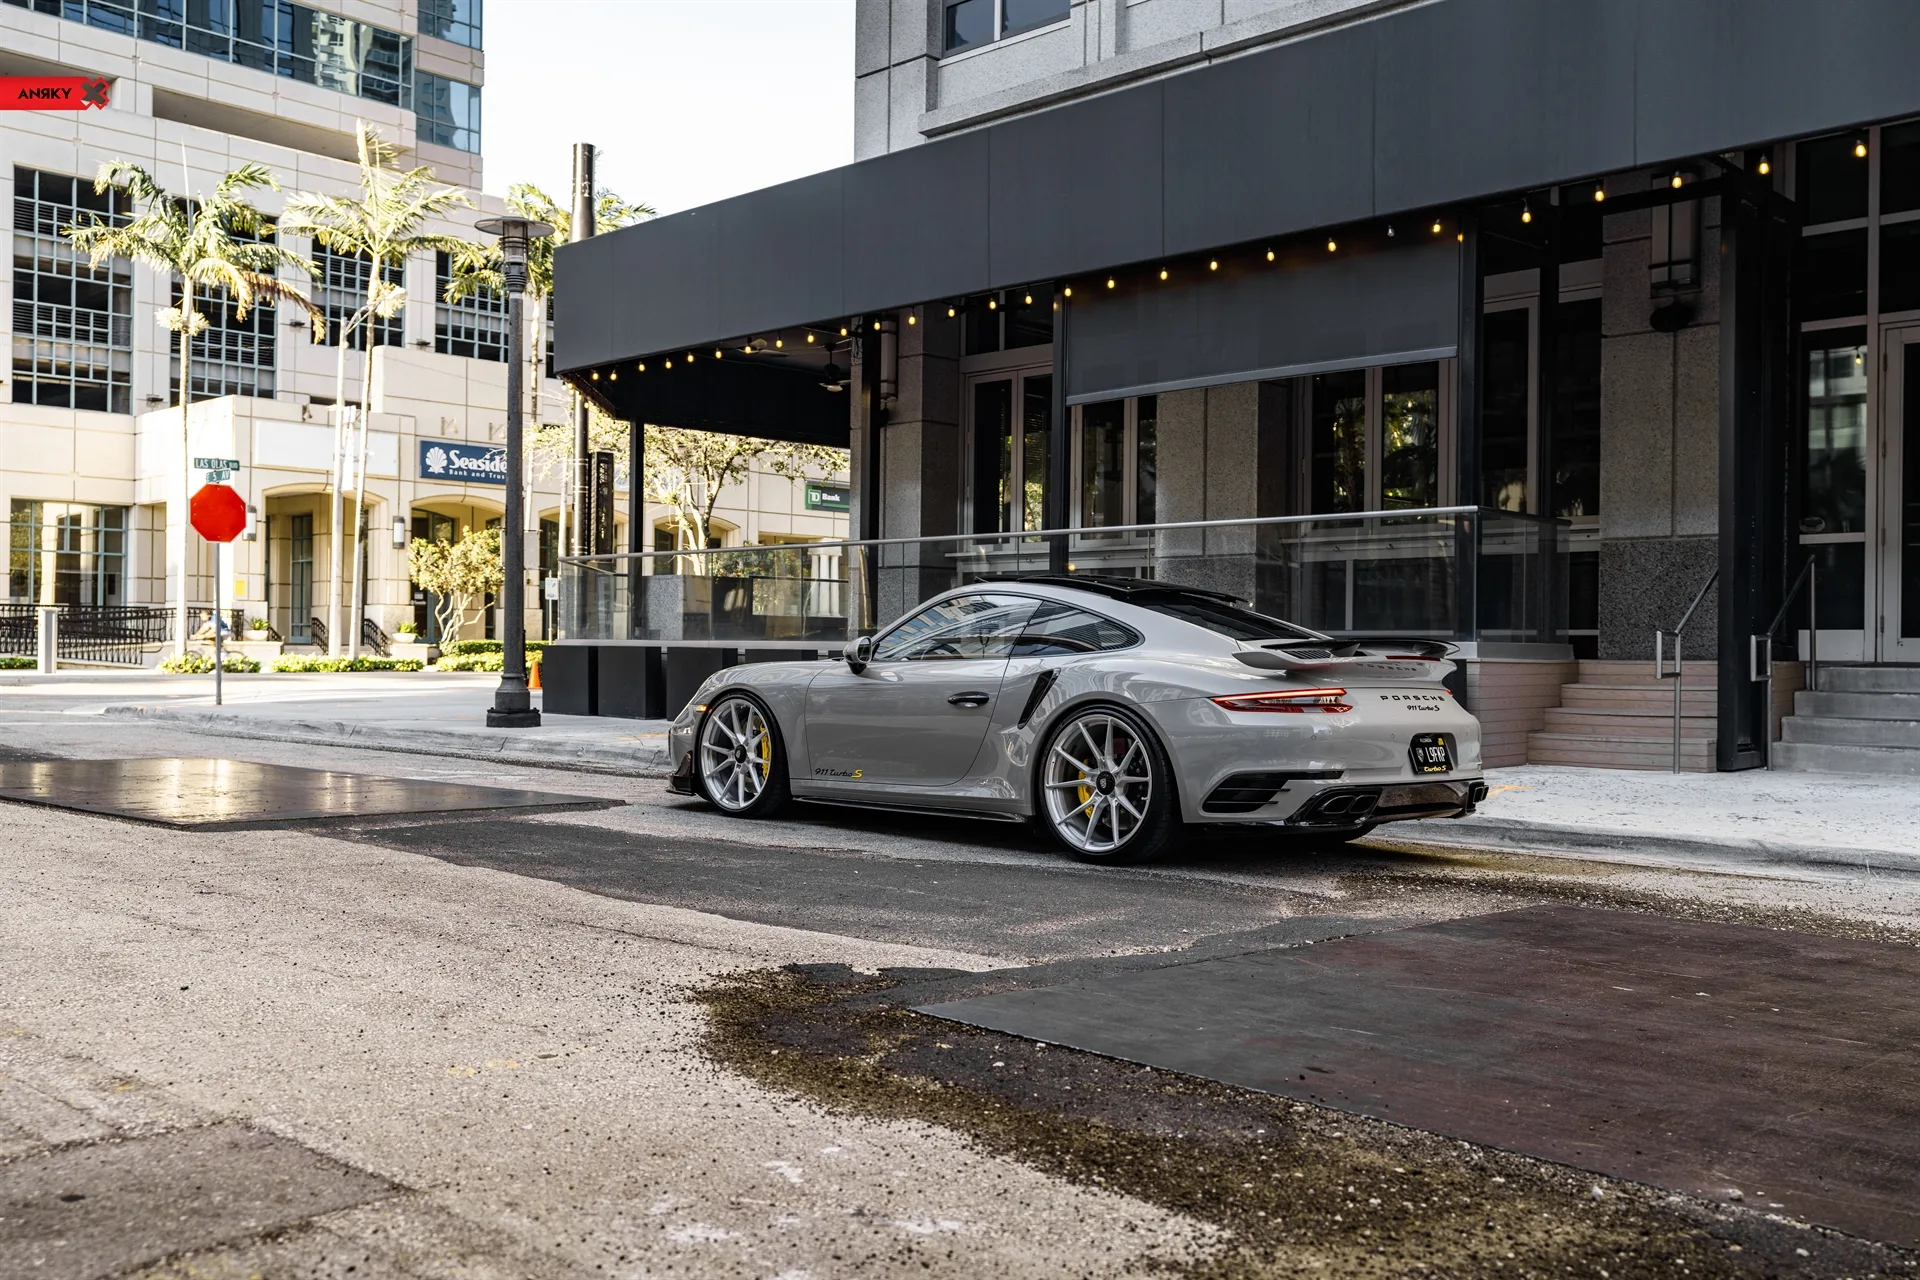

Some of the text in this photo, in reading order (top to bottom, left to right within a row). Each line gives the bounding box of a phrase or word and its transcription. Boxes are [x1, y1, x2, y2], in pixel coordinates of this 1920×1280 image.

[195, 458, 208, 468] LAS
[211, 459, 227, 469] OLAS
[449, 450, 507, 473] Seaside
[212, 471, 217, 481] 5
[221, 470, 230, 480] AV
[810, 492, 840, 502] TD Bank
[815, 768, 828, 776] 911
[851, 769, 863, 779] S
